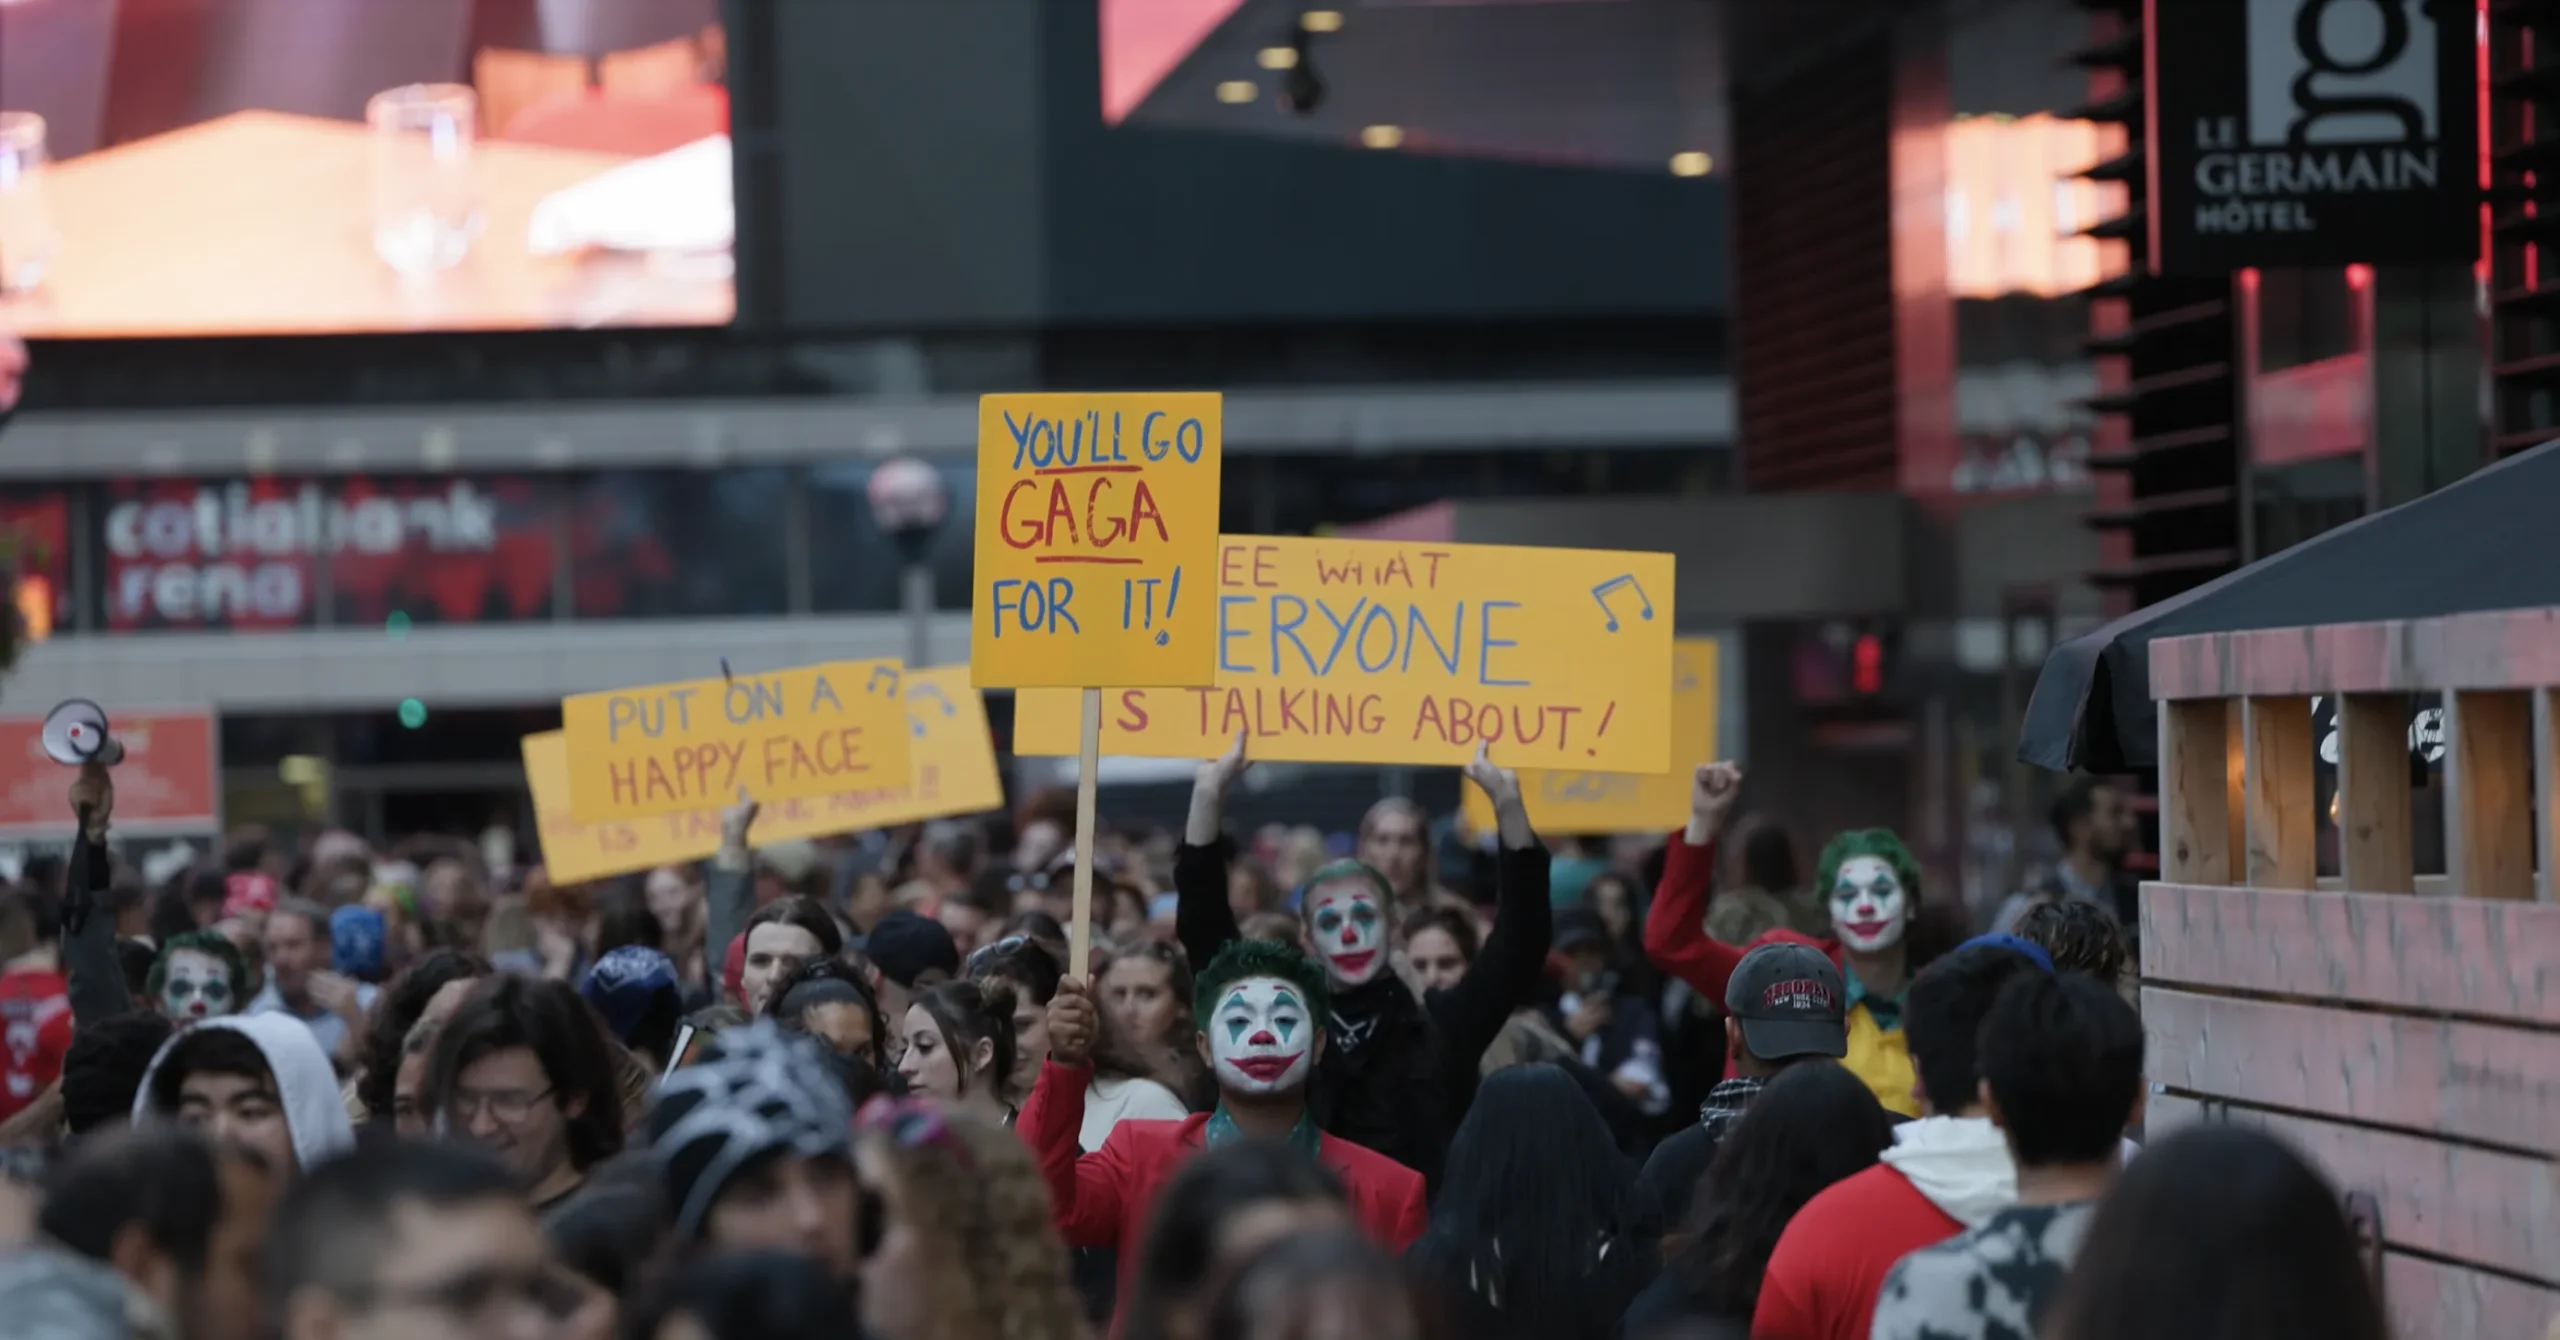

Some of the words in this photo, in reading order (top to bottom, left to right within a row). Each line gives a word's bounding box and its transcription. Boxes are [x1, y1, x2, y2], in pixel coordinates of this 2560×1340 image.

[2197, 116, 2237, 148] LE
[2195, 148, 2439, 196] GERMAIN
[2195, 197, 2316, 233] HÔTEL
[1003, 409, 1128, 470] YOU'LL
[1142, 411, 1203, 464] GO
[1001, 477, 1169, 549] GAGA
[117, 561, 303, 621] rena
[1221, 546, 1280, 588] EE
[1316, 549, 1451, 588] WHAT
[992, 577, 1080, 639] FOR
[1122, 565, 1181, 646] IT!
[1220, 594, 1531, 686] ERYONE
[608, 689, 697, 744] PUT
[724, 679, 784, 725] ON
[809, 674, 843, 714] A
[1185, 686, 1386, 737] TALKING
[608, 739, 746, 806] HAPPY
[763, 727, 871, 786] FACE
